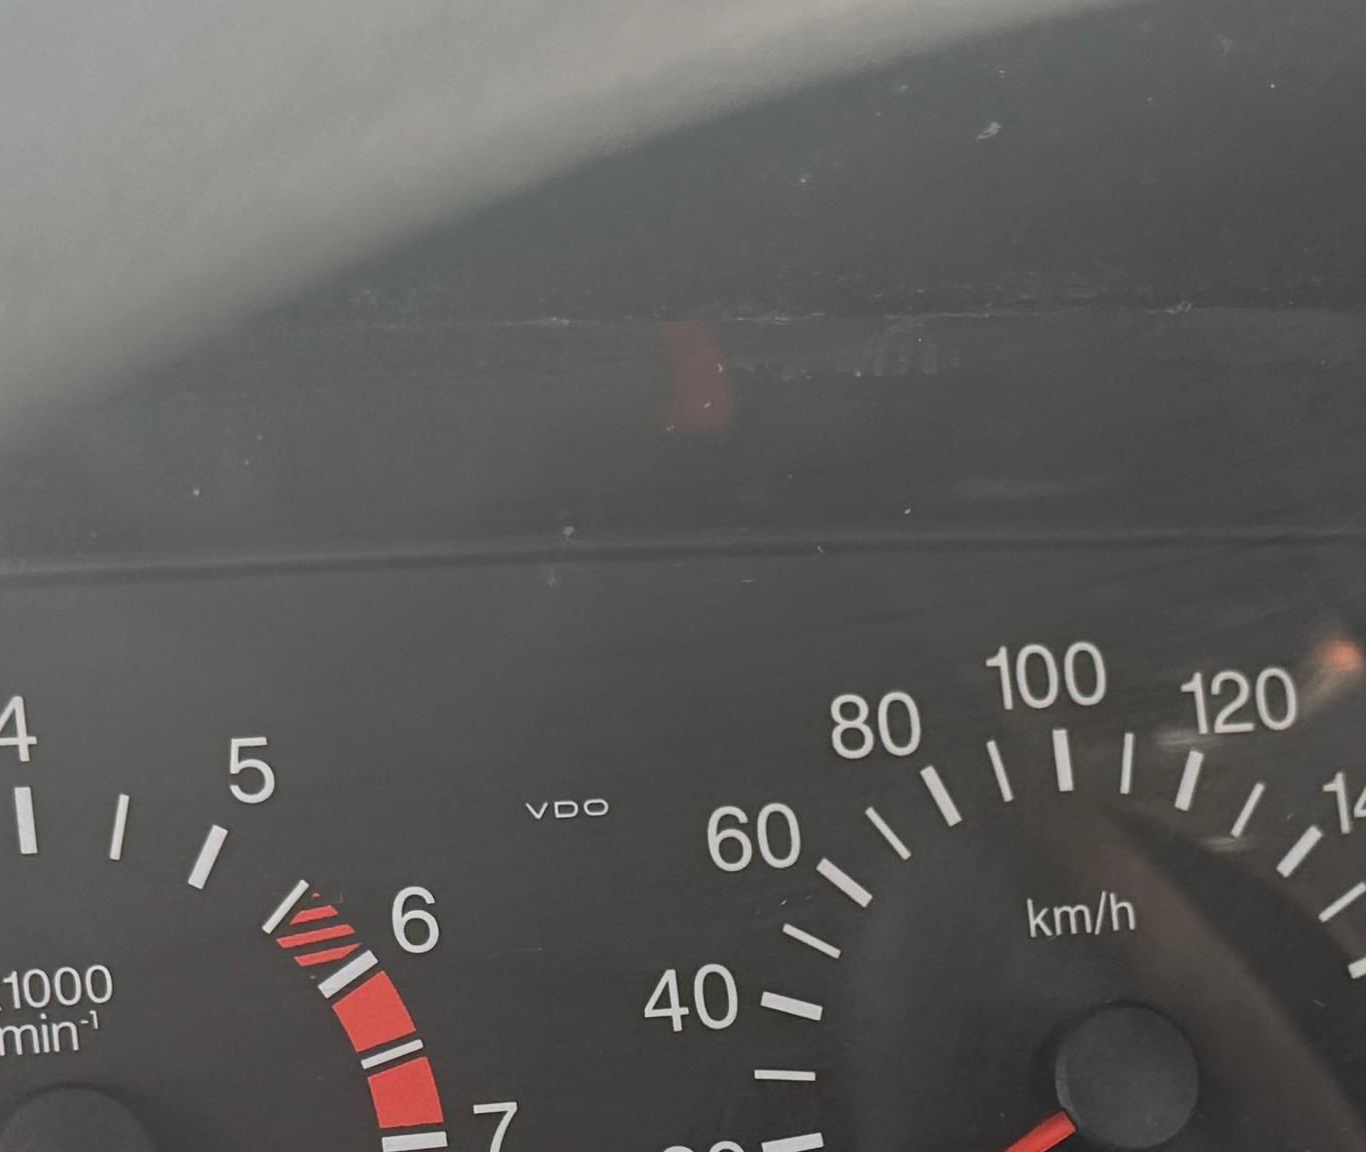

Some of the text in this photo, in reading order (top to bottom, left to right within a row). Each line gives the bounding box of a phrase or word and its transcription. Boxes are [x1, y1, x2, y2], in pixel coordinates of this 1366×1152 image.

[985, 641, 1108, 711] 100
[1180, 666, 1299, 736] 120
[830, 691, 922, 761] 80
[229, 736, 276, 803] 5
[525, 798, 610, 820] VDO
[705, 802, 802, 873] 60
[391, 886, 440, 954] 6
[1026, 893, 1137, 940] km/h
[643, 963, 740, 1032] 40
